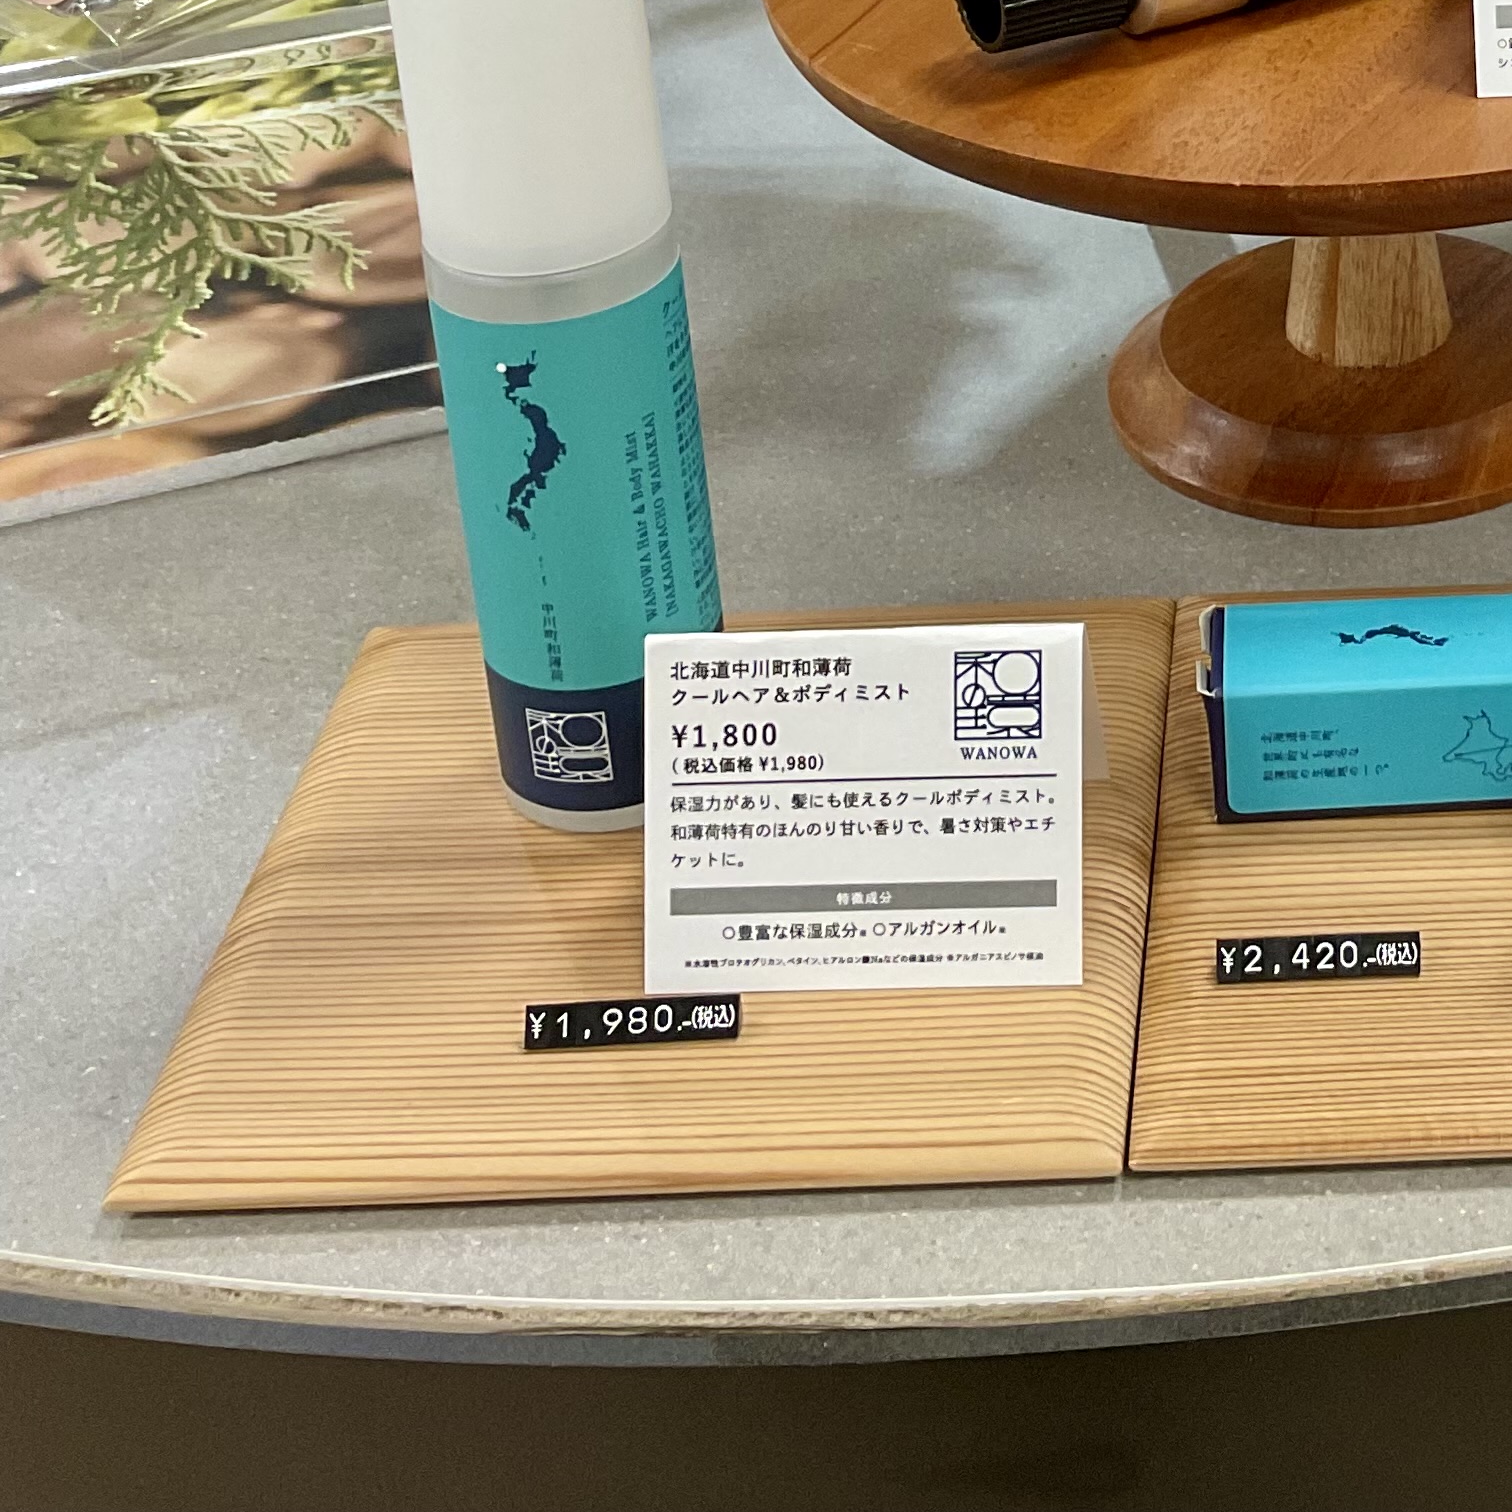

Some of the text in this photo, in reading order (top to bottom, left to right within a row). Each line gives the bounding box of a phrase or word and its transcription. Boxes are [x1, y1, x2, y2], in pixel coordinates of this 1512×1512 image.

[636, 519, 650, 552] Hair
[640, 551, 658, 623] WANOWA
[671, 657, 853, 682] 北海道中川町和薄荷
[671, 722, 778, 752] ¥1,800
[960, 745, 1039, 761] WANOWA
[670, 787, 1056, 813] 保湿力があり、髪にも使えるクールボディミスト。
[670, 816, 1057, 842] 和薄荷特有のほんのり甘い香りで、暑さ対策やエチ
[671, 851, 746, 869] ケットに。
[835, 890, 893, 906] 特徴成分
